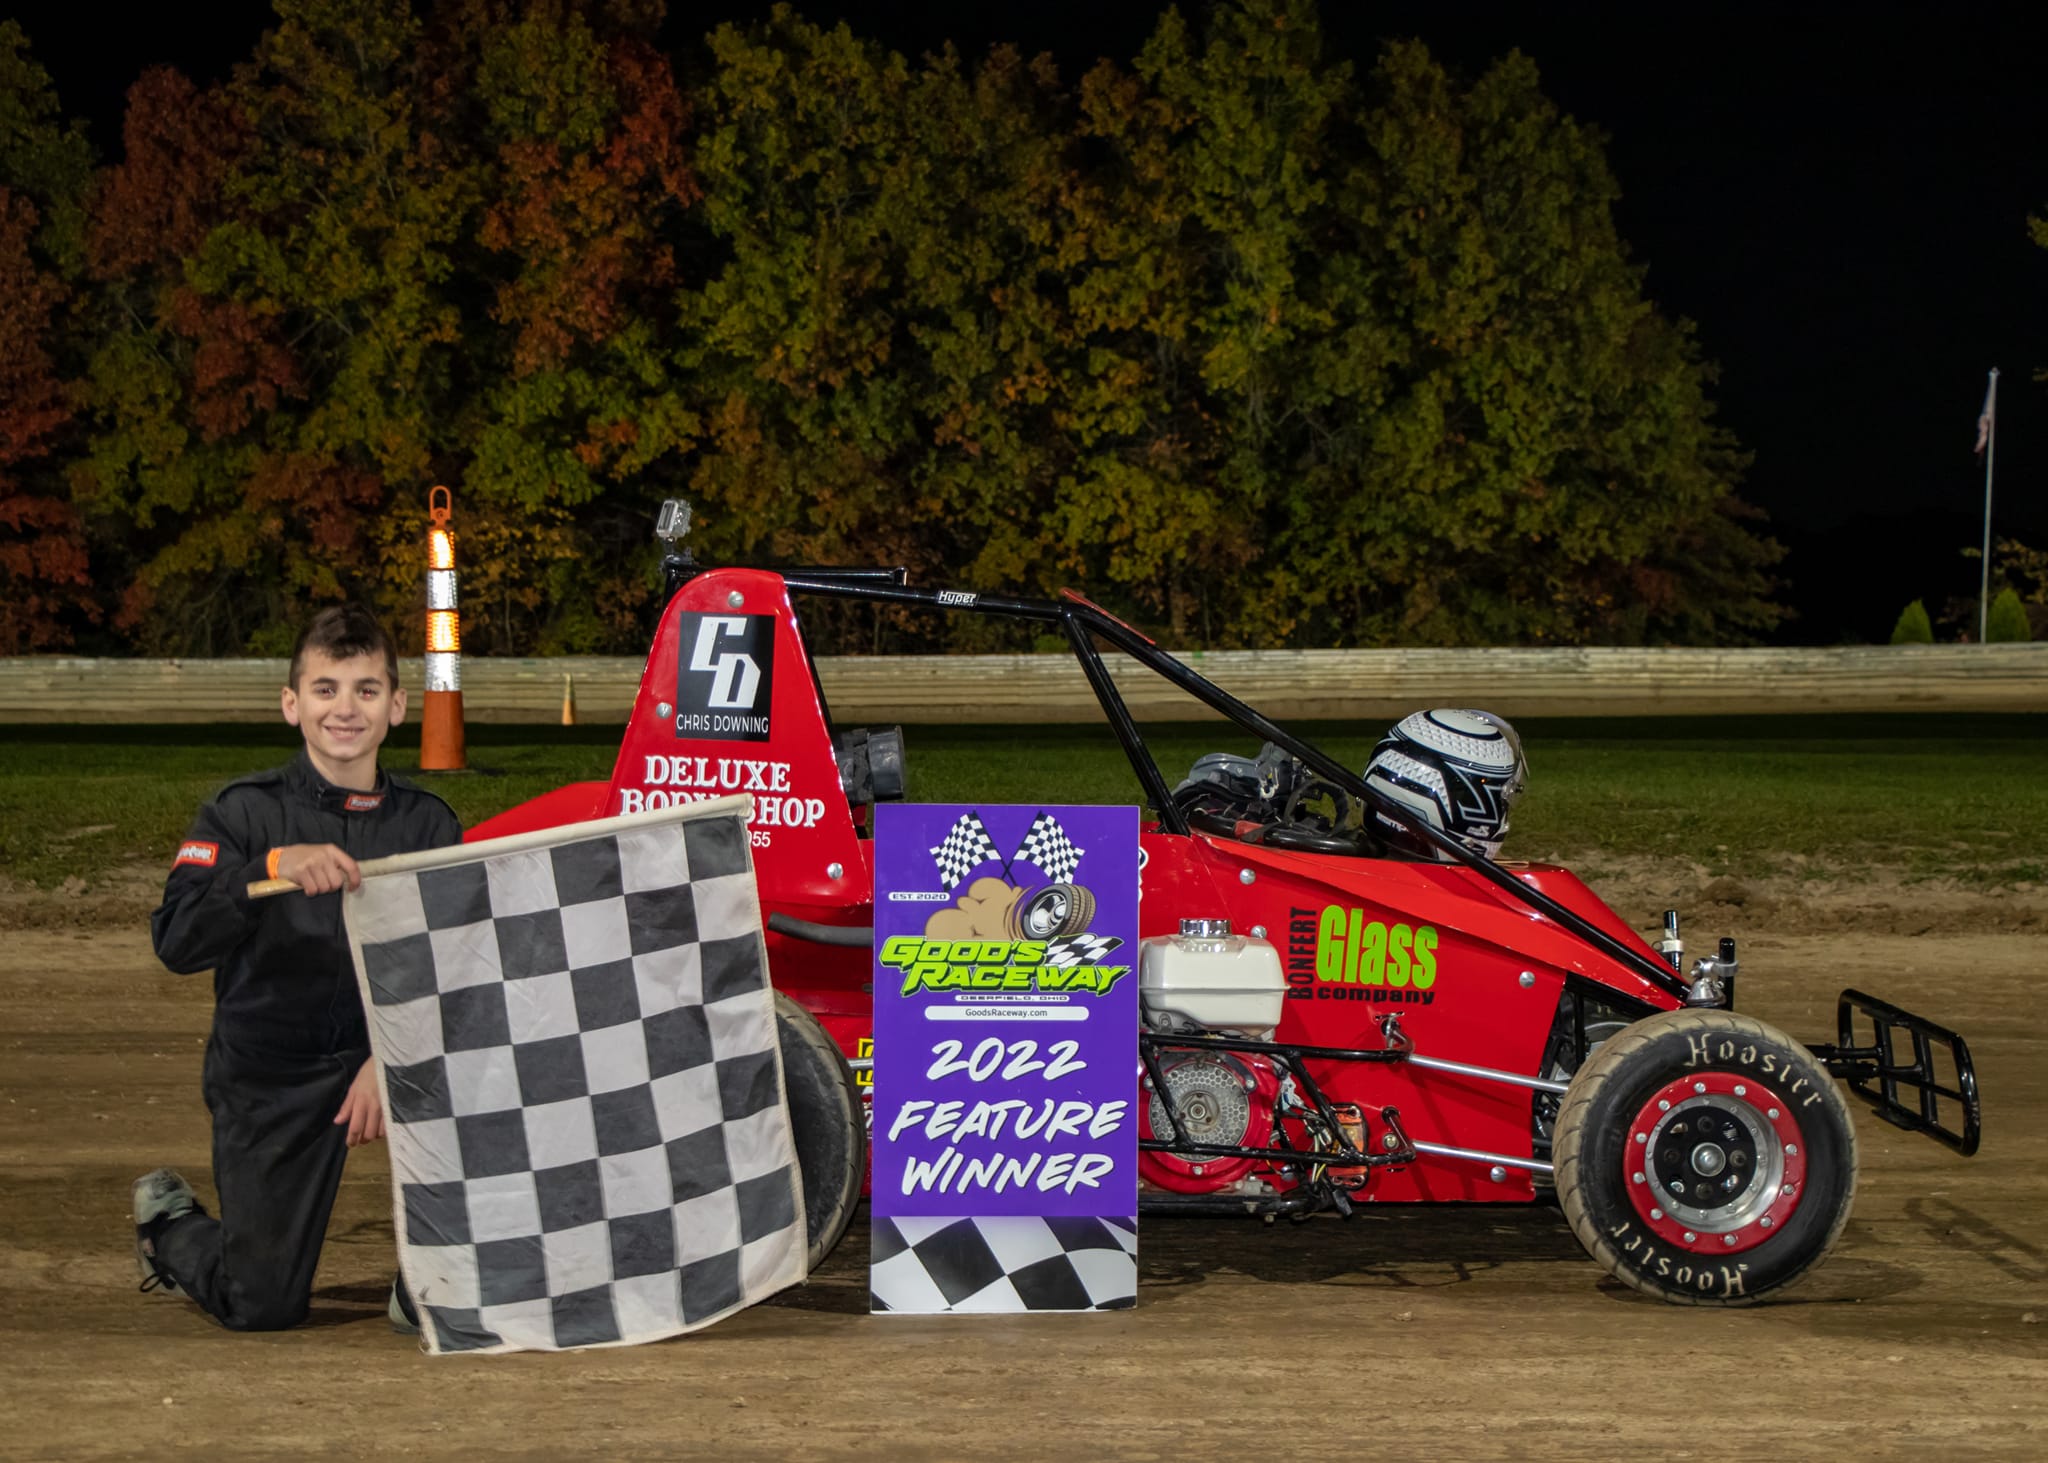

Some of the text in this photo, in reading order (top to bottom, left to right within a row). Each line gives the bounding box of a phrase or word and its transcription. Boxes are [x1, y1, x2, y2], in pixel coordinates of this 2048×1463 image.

[939, 591, 976, 604] Hyper
[676, 714, 769, 733] CHRIS DOWNING
[644, 755, 791, 792] DELUXE
[879, 936, 1051, 970] GOOD'S
[1287, 907, 1317, 1000] BONFERT
[1316, 904, 1439, 990] Glass
[901, 962, 1132, 997] RACEWAY
[1317, 987, 1435, 1005] company
[965, 1008, 1048, 1018] GoodsRaceway.com
[926, 1037, 1087, 1082] 2022
[888, 1099, 1128, 1144] FEATURE
[901, 1147, 1114, 1196] WINNER
